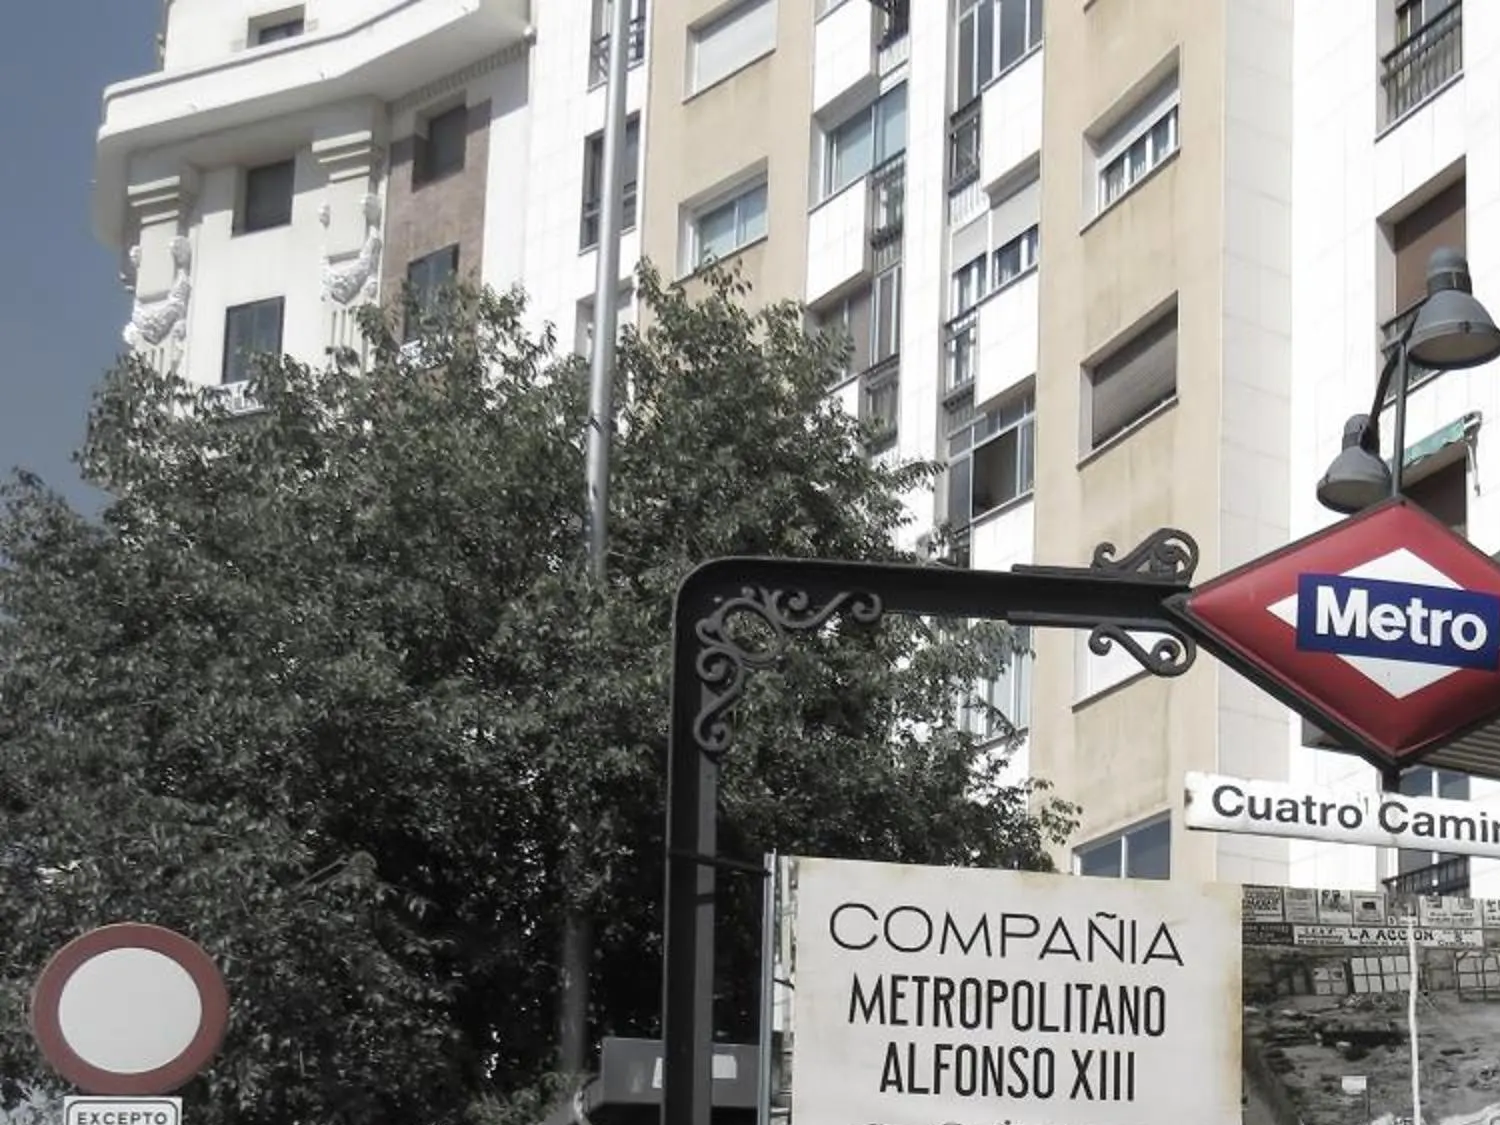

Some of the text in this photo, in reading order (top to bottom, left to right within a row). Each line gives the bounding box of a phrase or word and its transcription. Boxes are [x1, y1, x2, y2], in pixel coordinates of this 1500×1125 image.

[1315, 585, 1489, 651] Metro
[1212, 784, 1363, 830] Cuatro
[830, 902, 1184, 967] COMPAÑIA
[848, 973, 1166, 1037] METROPOLITANO
[879, 1041, 1136, 1101] ALFONSO XIII
